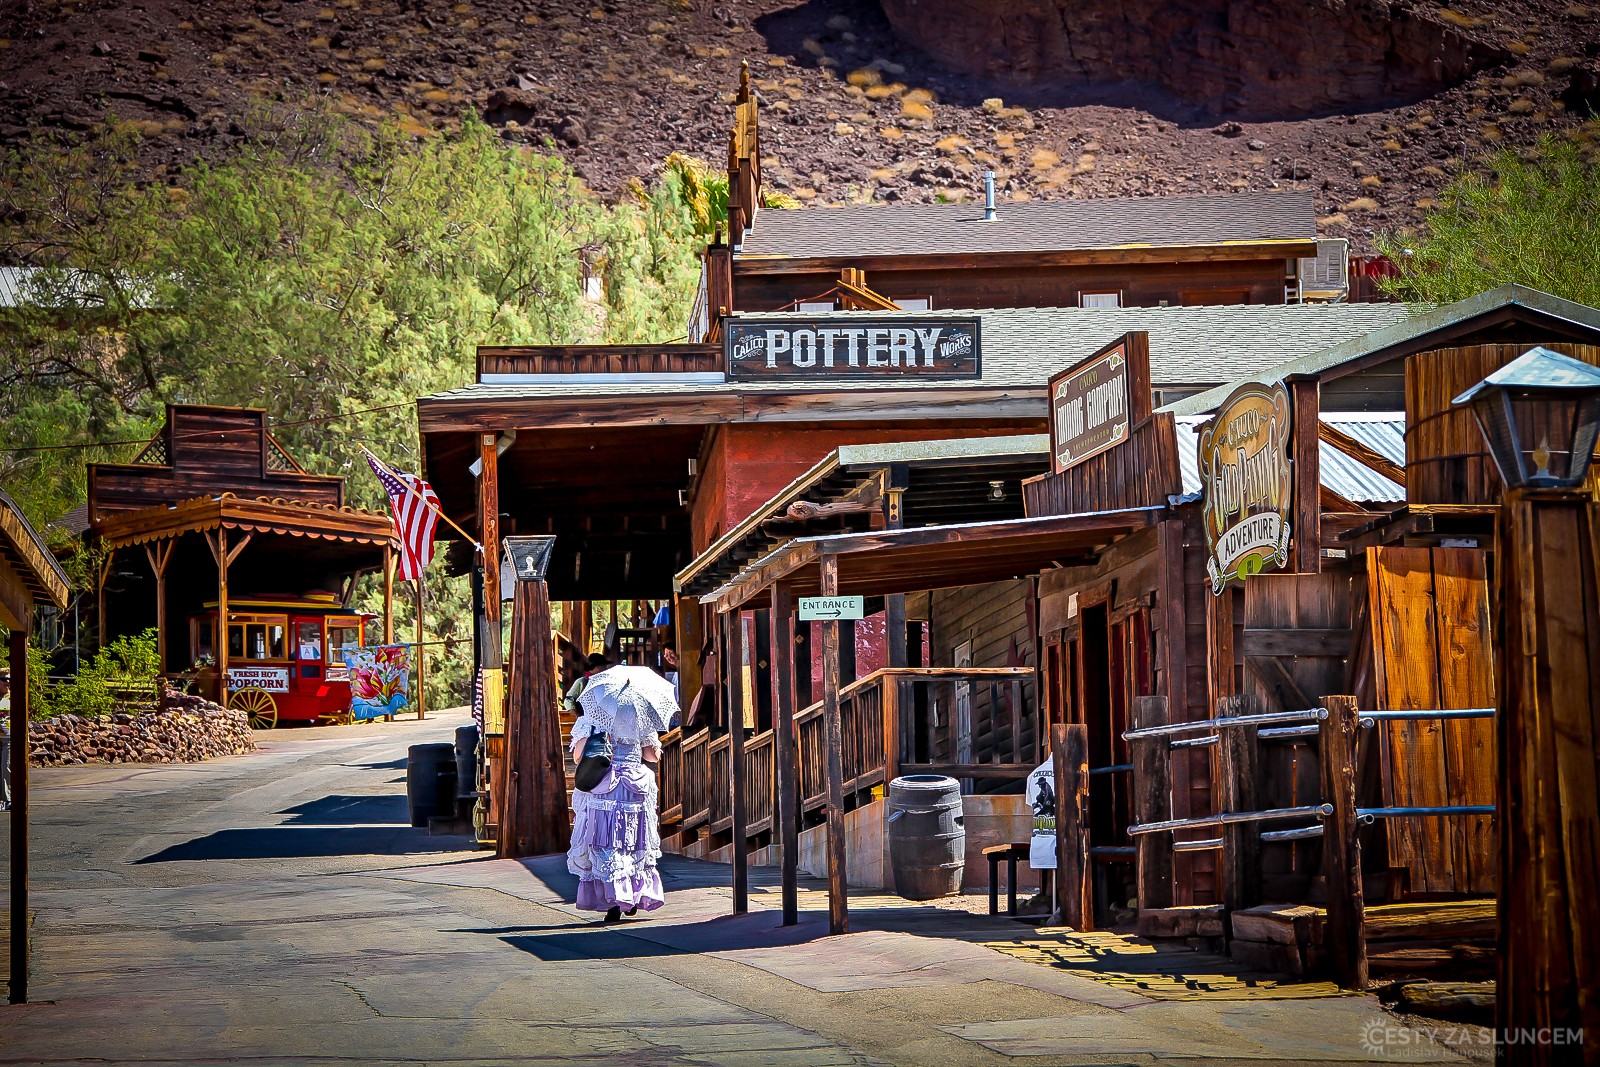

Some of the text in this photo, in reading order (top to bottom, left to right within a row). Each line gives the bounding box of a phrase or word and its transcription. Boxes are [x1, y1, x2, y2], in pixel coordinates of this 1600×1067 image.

[733, 328, 972, 368] CALICO POTTERY WORKS
[1057, 373, 1124, 446] MINING COMPANY
[1228, 408, 1260, 446] CALICO
[1224, 517, 1274, 561] ADVENTURE
[802, 600, 855, 610] ENTRANCE
[227, 679, 284, 688] POPCORN
